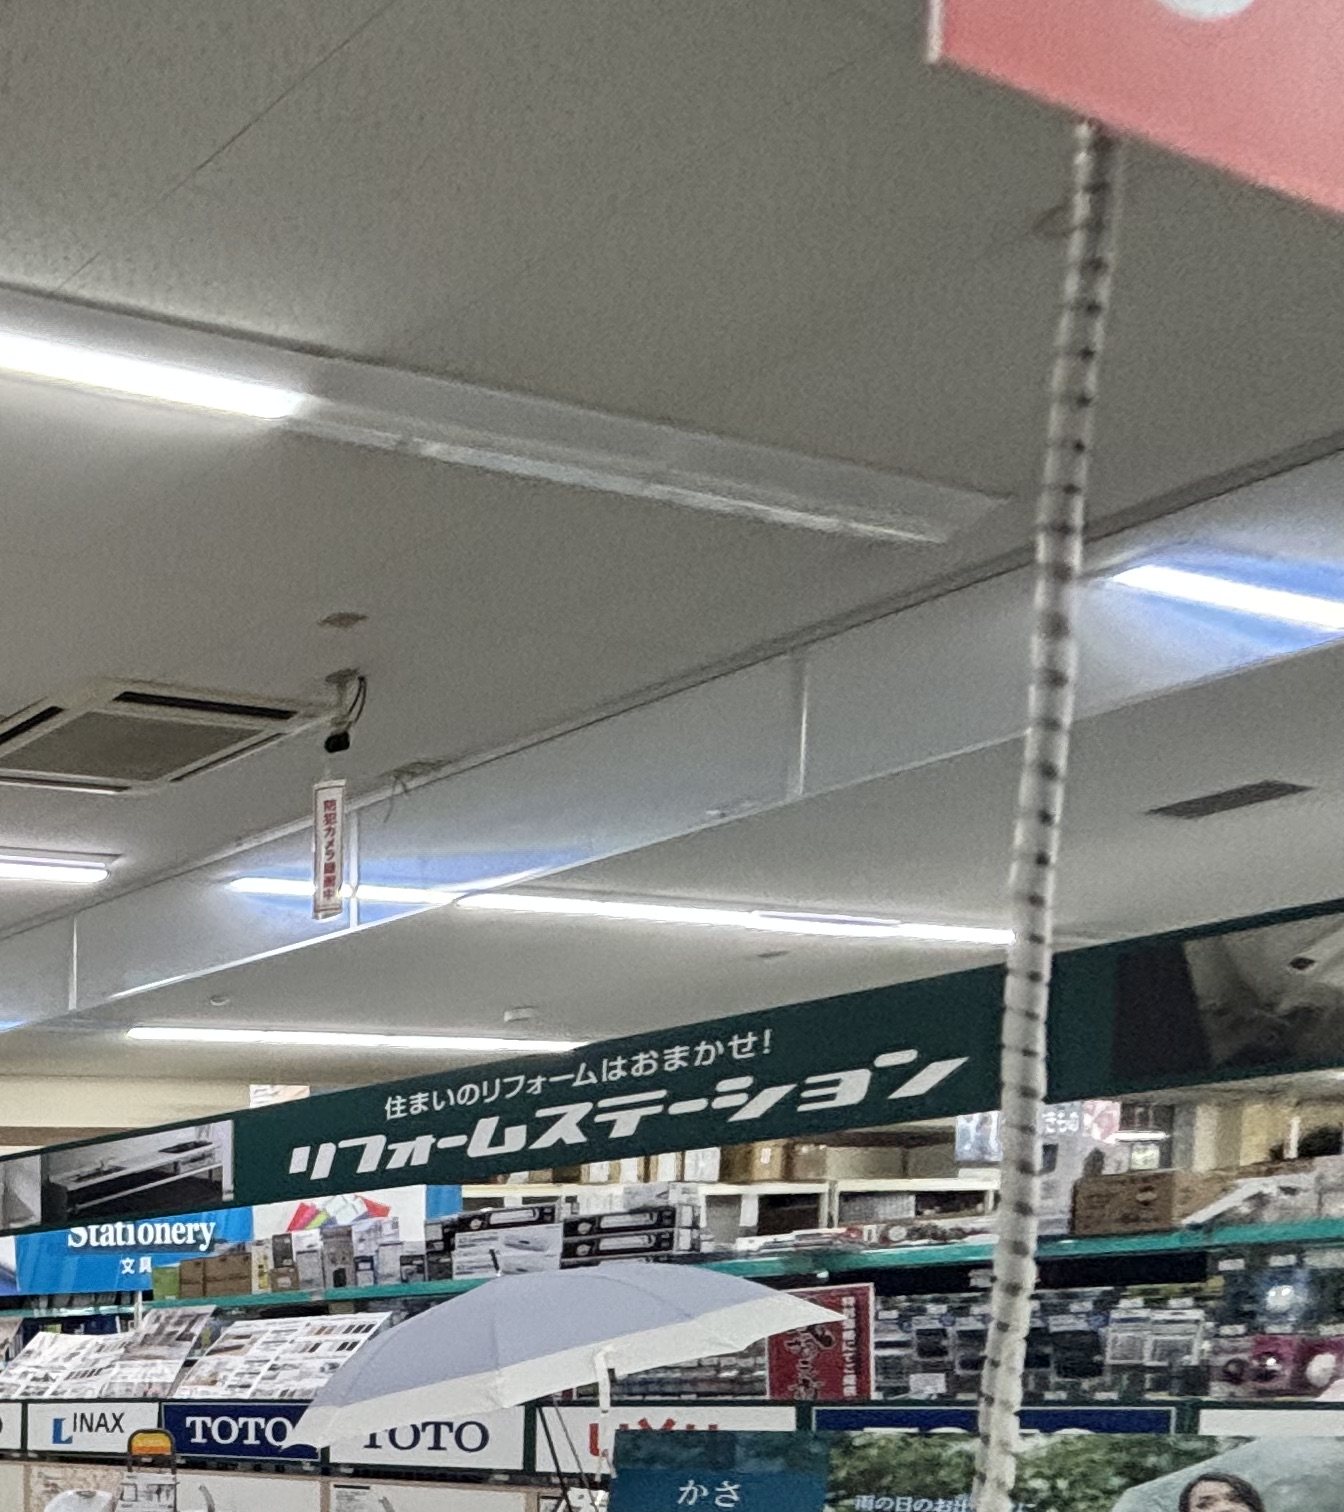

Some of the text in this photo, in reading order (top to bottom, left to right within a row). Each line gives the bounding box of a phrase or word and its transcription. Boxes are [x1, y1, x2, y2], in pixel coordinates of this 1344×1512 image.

[288, 1048, 969, 1181] リフォームステーション
[67, 1221, 216, 1252] Stationery
[120, 1256, 153, 1275] 文具
[72, 1411, 125, 1434] INAX
[185, 1416, 291, 1447] TOTO
[362, 1419, 491, 1454] TOTO
[678, 1479, 743, 1508] かさ
